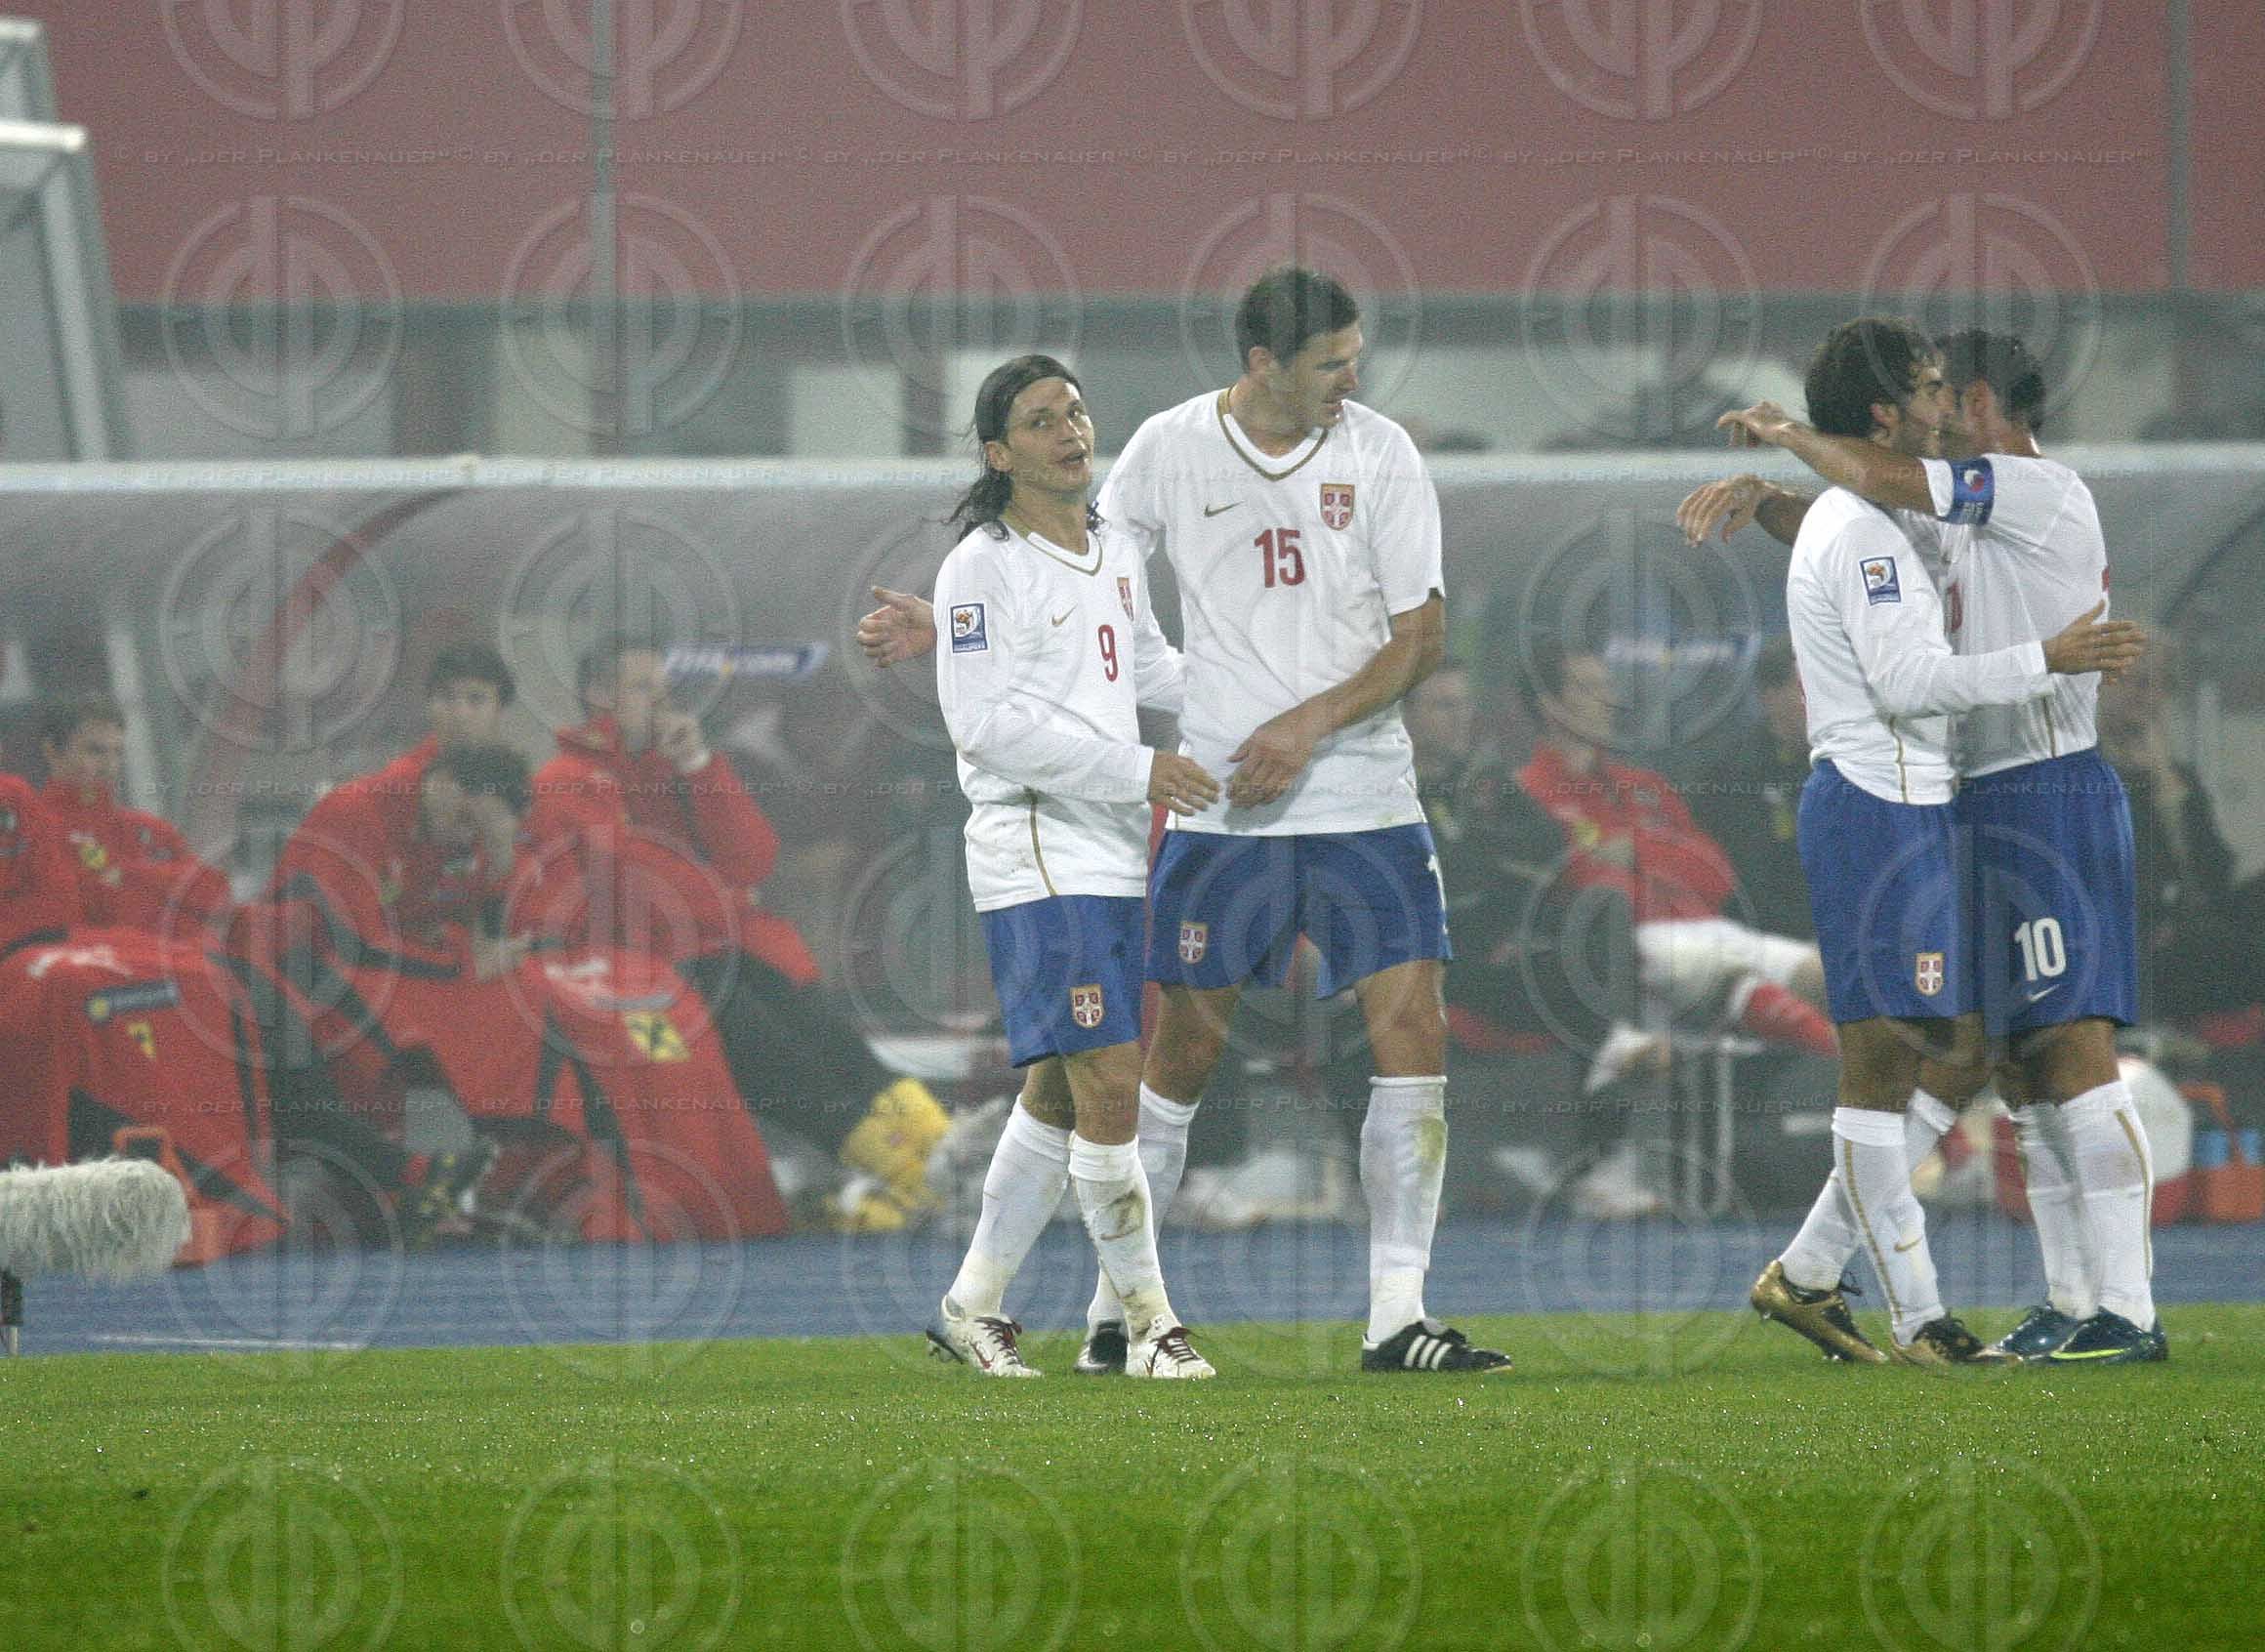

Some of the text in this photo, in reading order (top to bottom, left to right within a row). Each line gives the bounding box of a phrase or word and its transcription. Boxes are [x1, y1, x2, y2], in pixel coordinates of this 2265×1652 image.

[1254, 527, 1305, 588] 15
[1097, 624, 1119, 681] 9
[2014, 917, 2067, 981] 10
